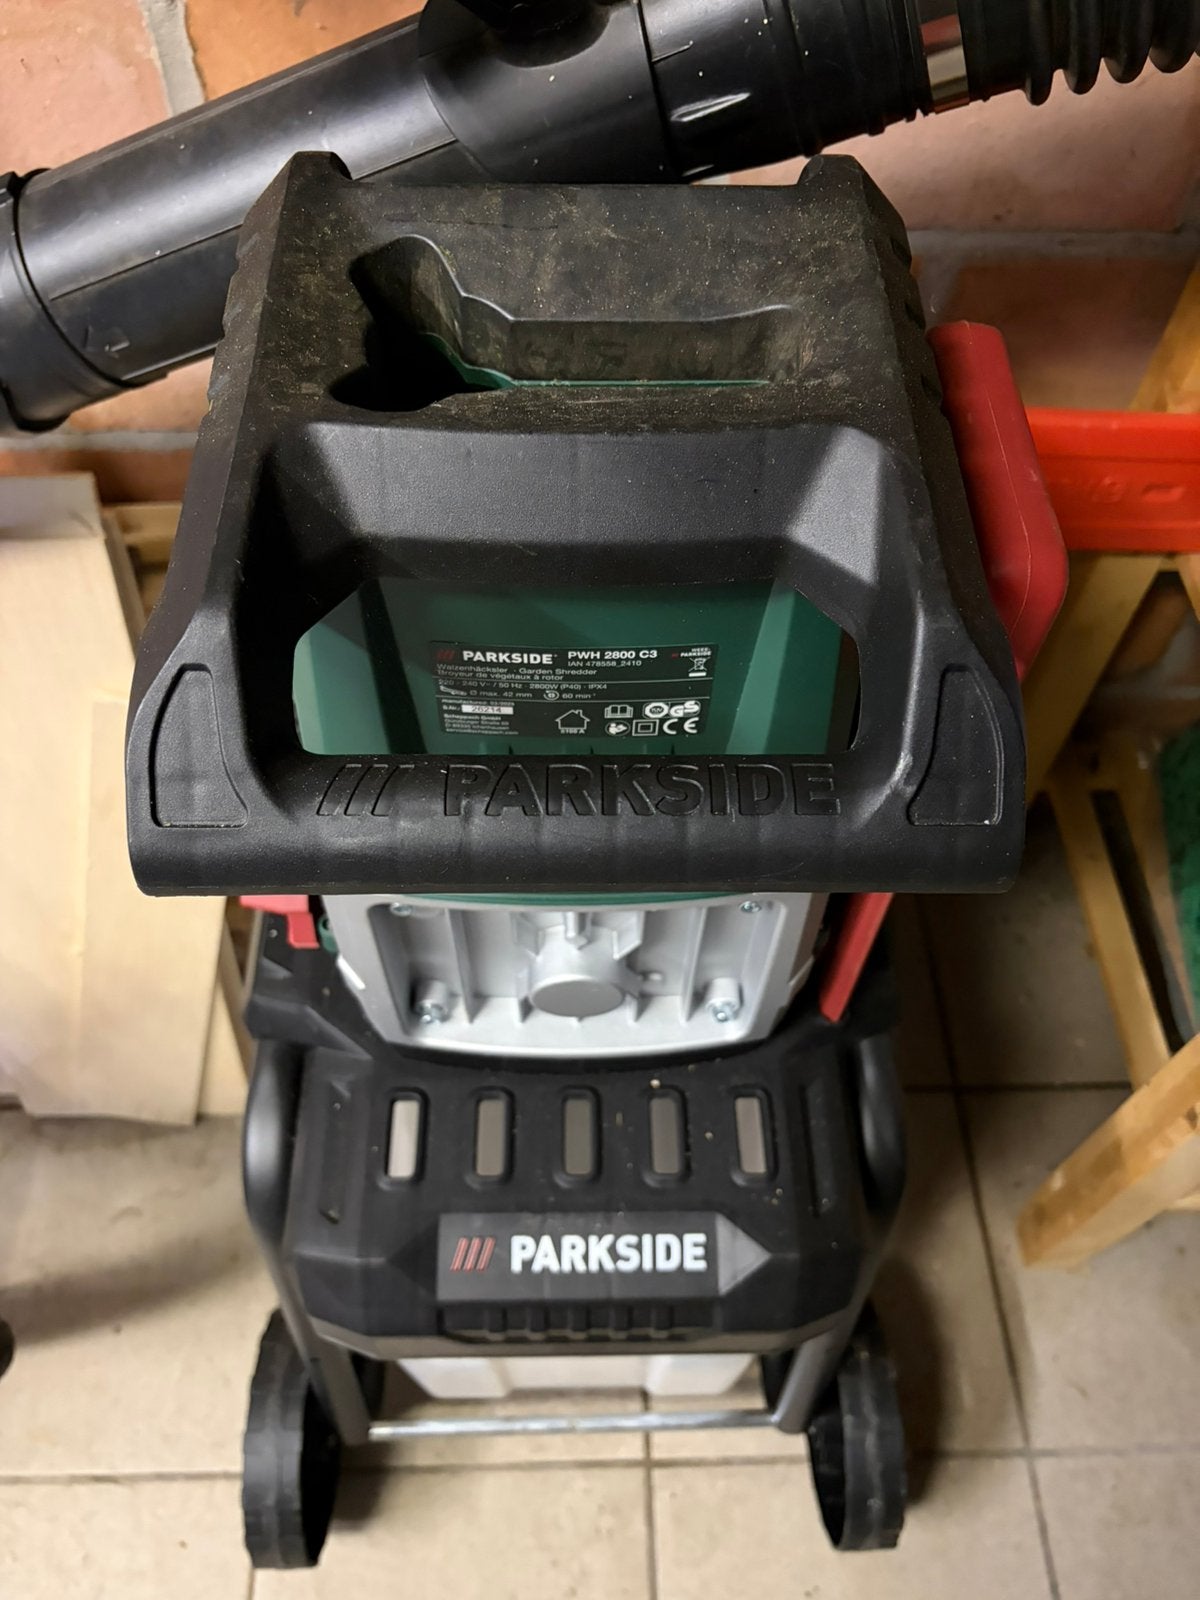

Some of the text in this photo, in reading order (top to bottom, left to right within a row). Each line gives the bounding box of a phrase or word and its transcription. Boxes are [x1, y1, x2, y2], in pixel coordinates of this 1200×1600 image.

[463, 651, 553, 664] PARKSIDE
[567, 649, 658, 660] PWH 2800 C3
[680, 650, 712, 658] PARKSIDE
[436, 663, 508, 674] Walzenhäcksler
[585, 660, 642, 668] 478558_2410
[490, 672, 531, 681] végétaux
[555, 668, 598, 676] Shredder
[511, 682, 522, 690] Hz
[502, 690, 515, 698] 42
[441, 762, 842, 817] PARKSIDE
[510, 1232, 708, 1274] PARKSIDE
